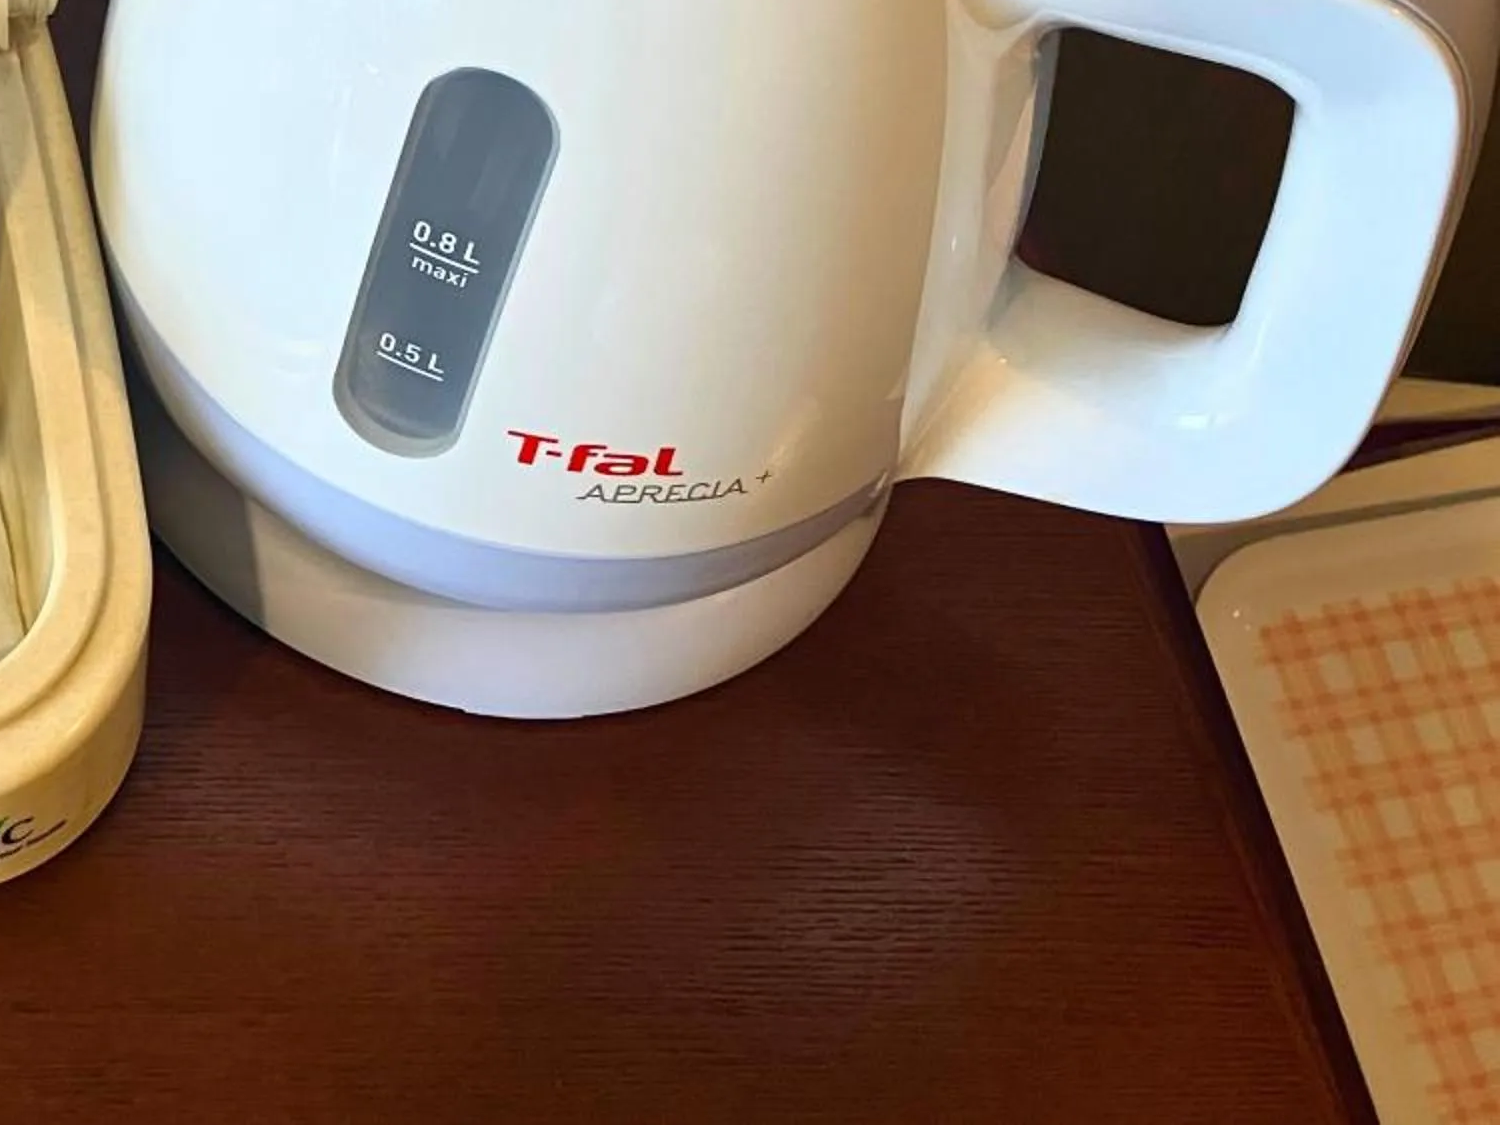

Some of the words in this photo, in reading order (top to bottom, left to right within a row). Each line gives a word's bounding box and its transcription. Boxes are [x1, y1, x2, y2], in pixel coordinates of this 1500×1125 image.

[413, 221, 457, 254] 0.8
[463, 241, 480, 265] L
[411, 256, 469, 288] maxi
[379, 332, 422, 364] 0.5
[427, 354, 444, 374] L
[508, 430, 684, 477] T-fal
